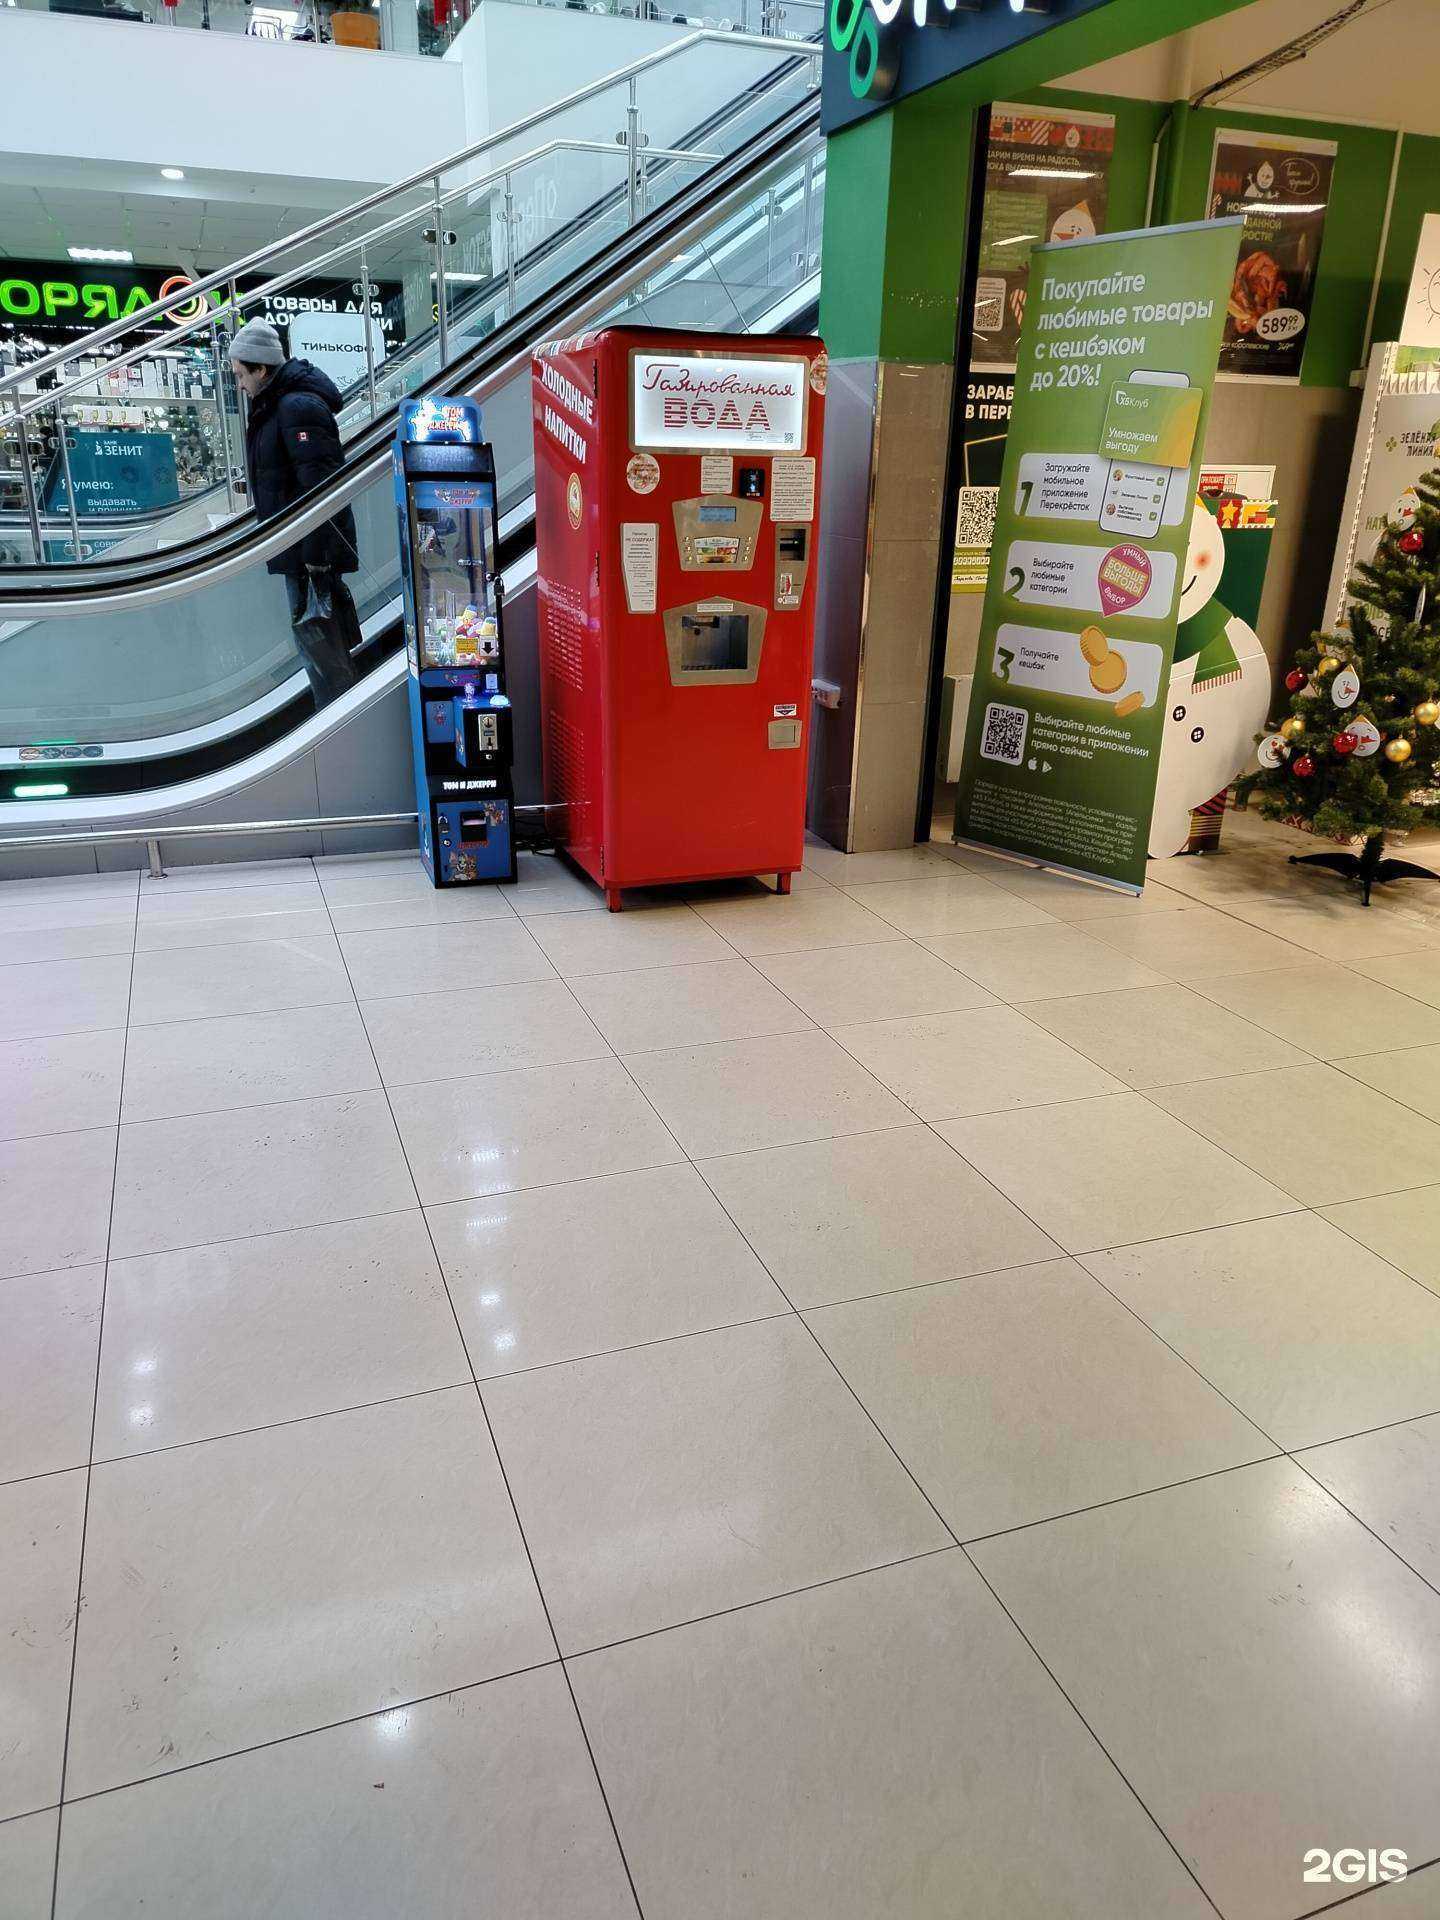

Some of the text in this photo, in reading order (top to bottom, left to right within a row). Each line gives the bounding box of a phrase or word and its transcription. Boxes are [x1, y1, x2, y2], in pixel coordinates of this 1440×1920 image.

[1012, 153, 1035, 162] ВРЕМЯ
[1047, 155, 1080, 167] РАДОСТЬ,
[1041, 272, 1146, 303] Покупайте
[1037, 300, 1215, 330] любимые товары
[1262, 316, 1288, 334] 589
[1034, 334, 1146, 360] с кешбэком
[642, 363, 796, 398] Газированная
[1029, 364, 1102, 391] до 20%!
[541, 361, 593, 426] ХОЛОДНЫЕ
[966, 384, 1015, 400] ЗАРАБ
[664, 397, 771, 431] ВОДА
[965, 404, 975, 419] В
[544, 405, 587, 464] НАПИТКИ
[1109, 427, 1158, 443] Умножаем
[104, 445, 143, 456] ЗЕНИТ
[1406, 445, 1434, 457] ЛИНИЯ
[1044, 463, 1090, 474] Загружайте
[73, 481, 114, 492] умею:
[1043, 476, 1085, 486] мобильное
[1021, 481, 1034, 517] 1
[1041, 489, 1089, 498] приложение
[87, 498, 137, 506] выдавать
[1040, 500, 1091, 511] Перекрёсток
[1032, 557, 1075, 571] Выбирайте
[1107, 559, 1147, 584] БОЛЬШЕ
[1005, 566, 1026, 600] 2
[1030, 571, 1066, 582] любимые
[1029, 583, 1069, 595] категории
[1020, 646, 1060, 661] Получайте
[996, 646, 1015, 684] 3
[1019, 660, 1046, 671] кешбэк
[1034, 712, 1132, 740] Выбирайте любимые
[1031, 740, 1094, 759] прямо сейчас
[1032, 727, 1149, 757] категории в приложении
